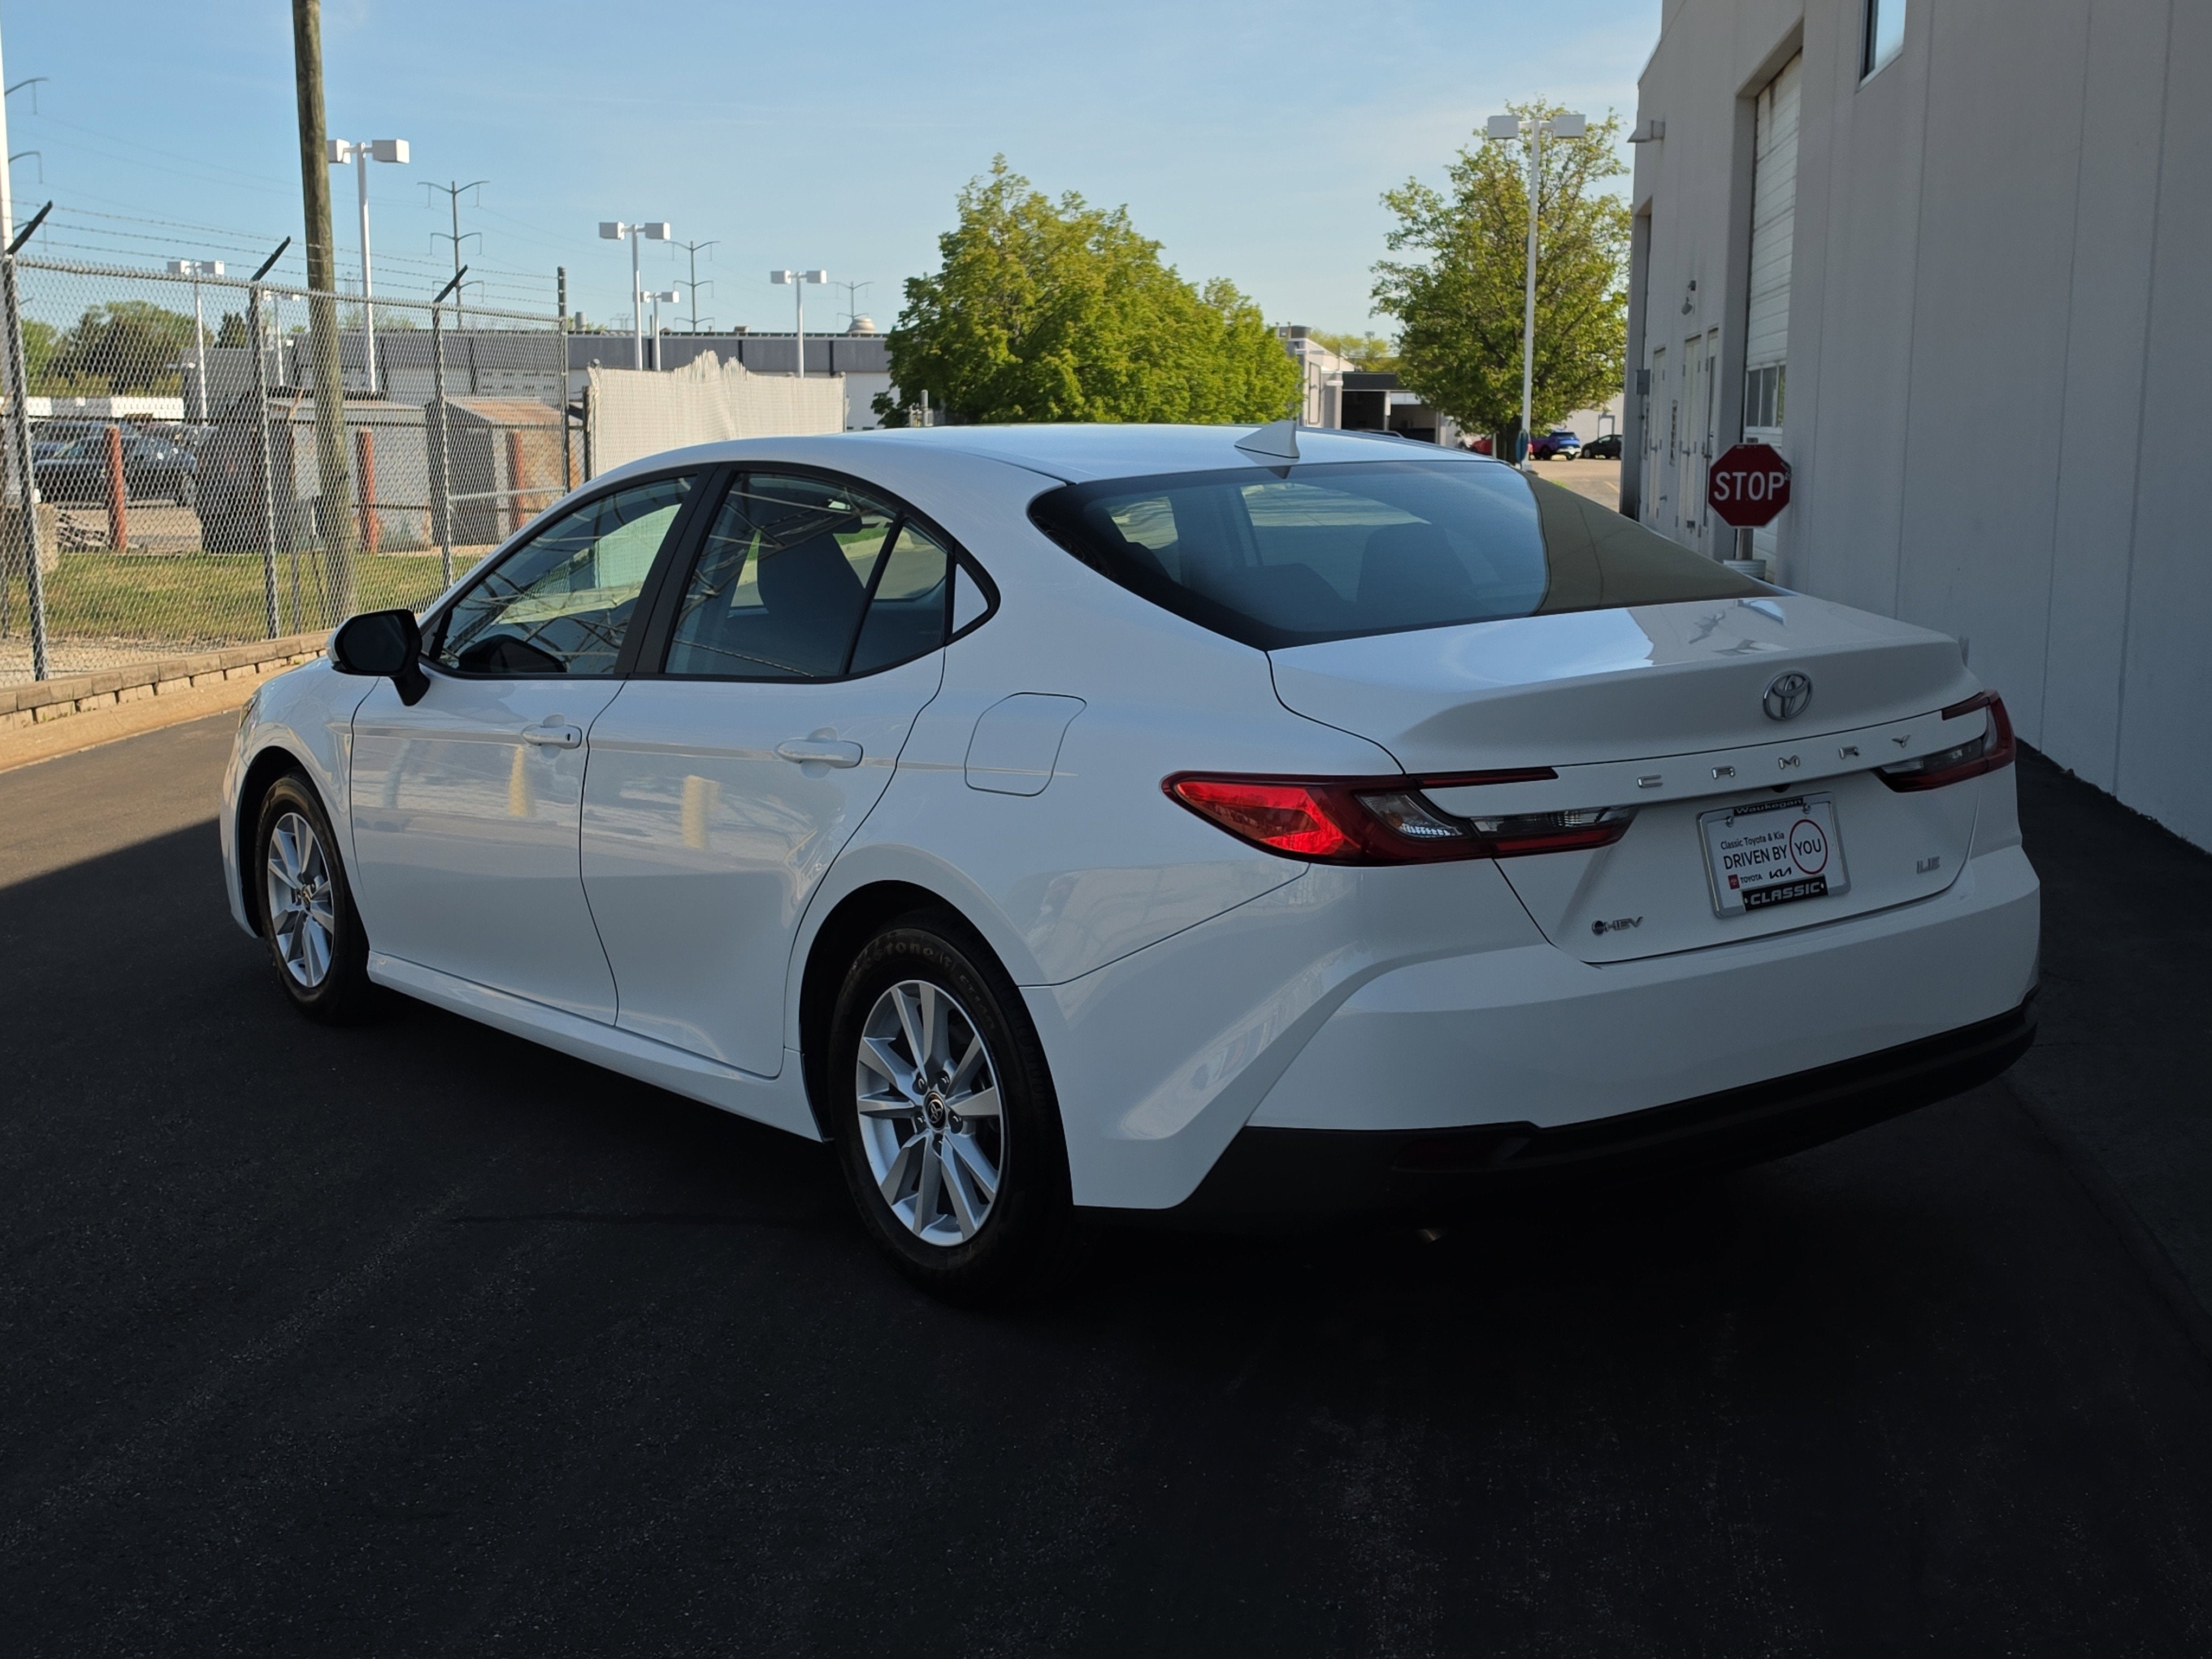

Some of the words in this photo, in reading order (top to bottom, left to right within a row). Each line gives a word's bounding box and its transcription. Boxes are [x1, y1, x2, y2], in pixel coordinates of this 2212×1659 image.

[1714, 471, 1785, 501] STOP
[1636, 734, 1911, 788] CAMRY
[1736, 799, 1803, 814] Waukegan
[1720, 838, 1744, 850] Classic
[1744, 835, 1767, 847] Toyota
[1773, 831, 1785, 840] Kia
[1724, 848, 1770, 870] DRIVEN
[1772, 844, 1788, 861] BY
[1794, 838, 1822, 856] YOU
[1740, 873, 1763, 884] TOYOTA
[1750, 882, 1821, 906] CLASSIC
[1604, 916, 1643, 932] HEV
